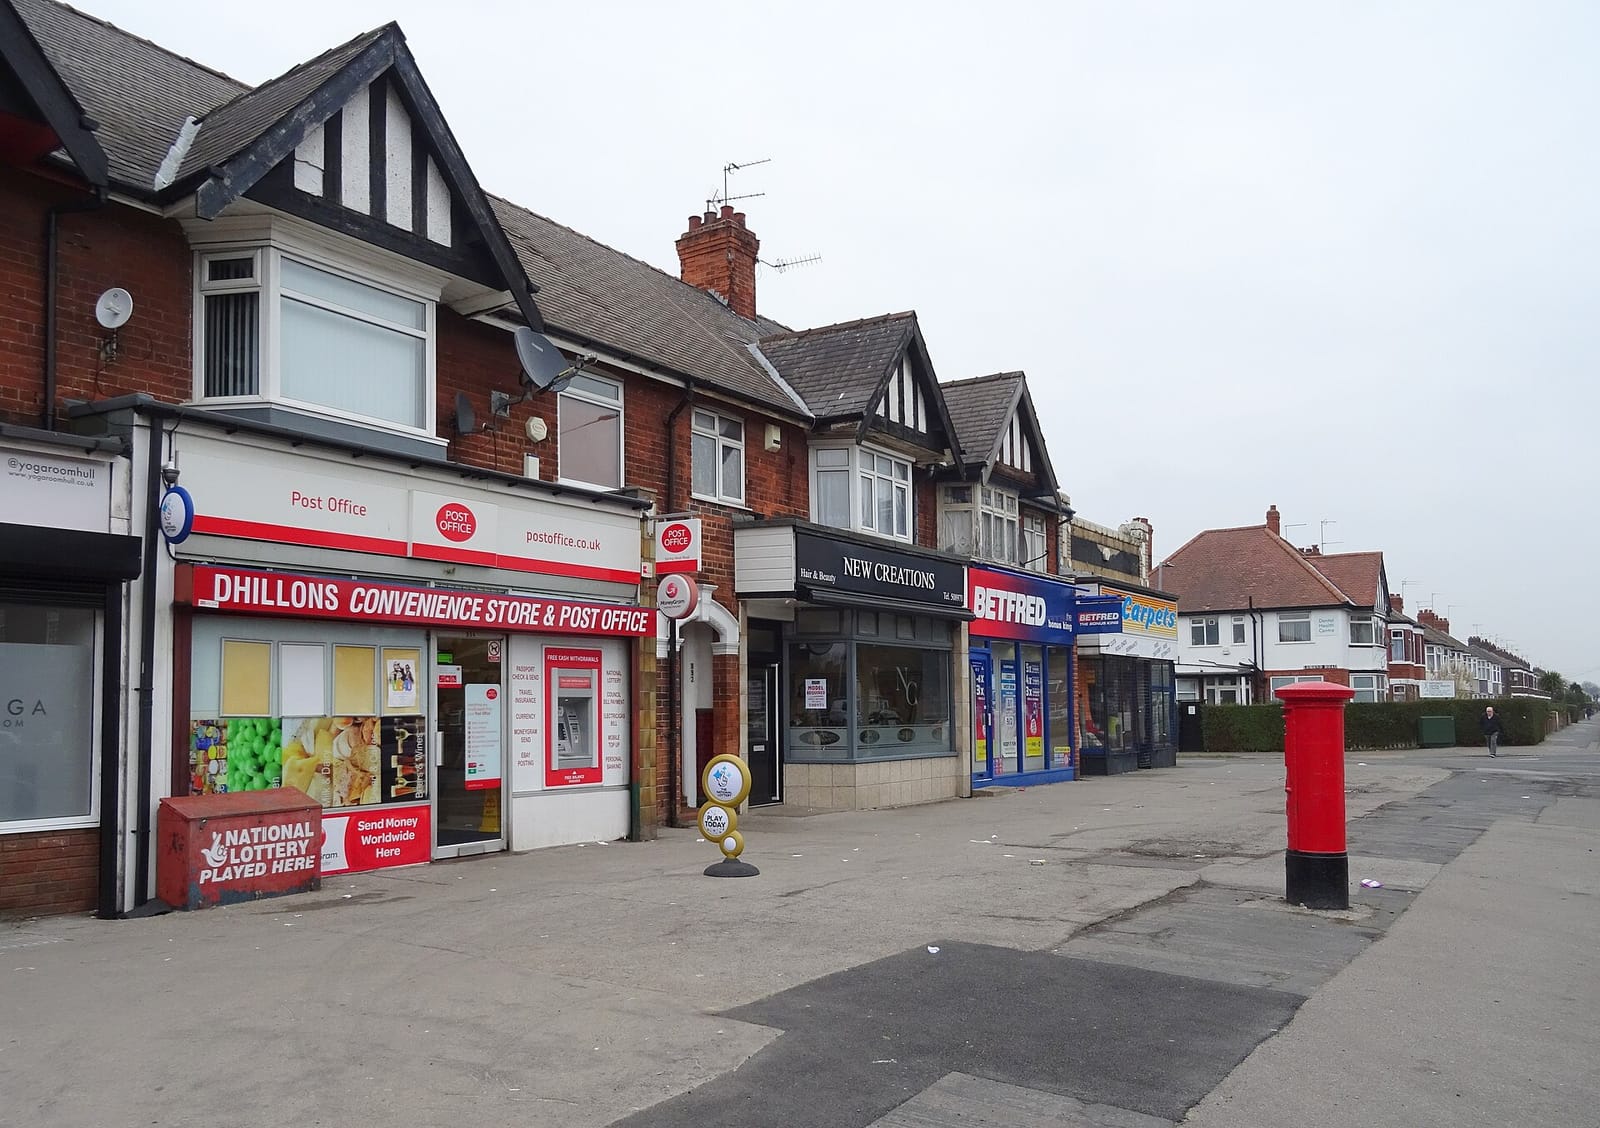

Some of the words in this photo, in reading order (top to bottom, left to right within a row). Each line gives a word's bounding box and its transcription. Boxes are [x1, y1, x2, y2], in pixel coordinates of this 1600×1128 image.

[8, 457, 95, 479] @yogaroomhull
[8, 471, 95, 488] www.yogaroomhull.co.uk
[291, 491, 322, 510] Post
[327, 496, 366, 516] Office
[445, 510, 469, 523] POST
[439, 520, 472, 534] OFFICE
[668, 529, 685, 539] POST
[526, 530, 601, 552] postoffice.co.uk
[664, 537, 688, 547] OFFICE
[800, 568, 812, 579] Hair
[813, 571, 818, 580] &
[819, 571, 837, 585] Beauty
[843, 557, 873, 579] NEW
[874, 563, 935, 590] CREATIONS
[214, 573, 338, 610] DHILLONS
[349, 587, 483, 622] CONVENIENCE
[485, 599, 539, 626] STORE
[543, 604, 555, 627] &
[558, 605, 600, 631] POST
[601, 609, 649, 634] OFFICE
[973, 586, 1047, 628] BETFRED
[1079, 613, 1119, 622] BETFRED
[1121, 595, 1176, 630] Carpets
[1048, 620, 1062, 630] bonus
[1063, 621, 1072, 632] king
[570, 655, 599, 663] WITHDRAWALS
[8, 699, 46, 715] GA
[415, 732, 424, 762] Wines
[357, 818, 384, 831] Send
[385, 817, 418, 829] Money
[704, 820, 726, 829] TODAY
[706, 814, 723, 822] PLAY
[226, 822, 314, 847] NATIONAL
[361, 830, 415, 846] Worldwide
[230, 839, 310, 864] LOTTERY
[376, 847, 401, 858] Here
[199, 862, 267, 884] PLAYED
[271, 855, 316, 874] HERE
